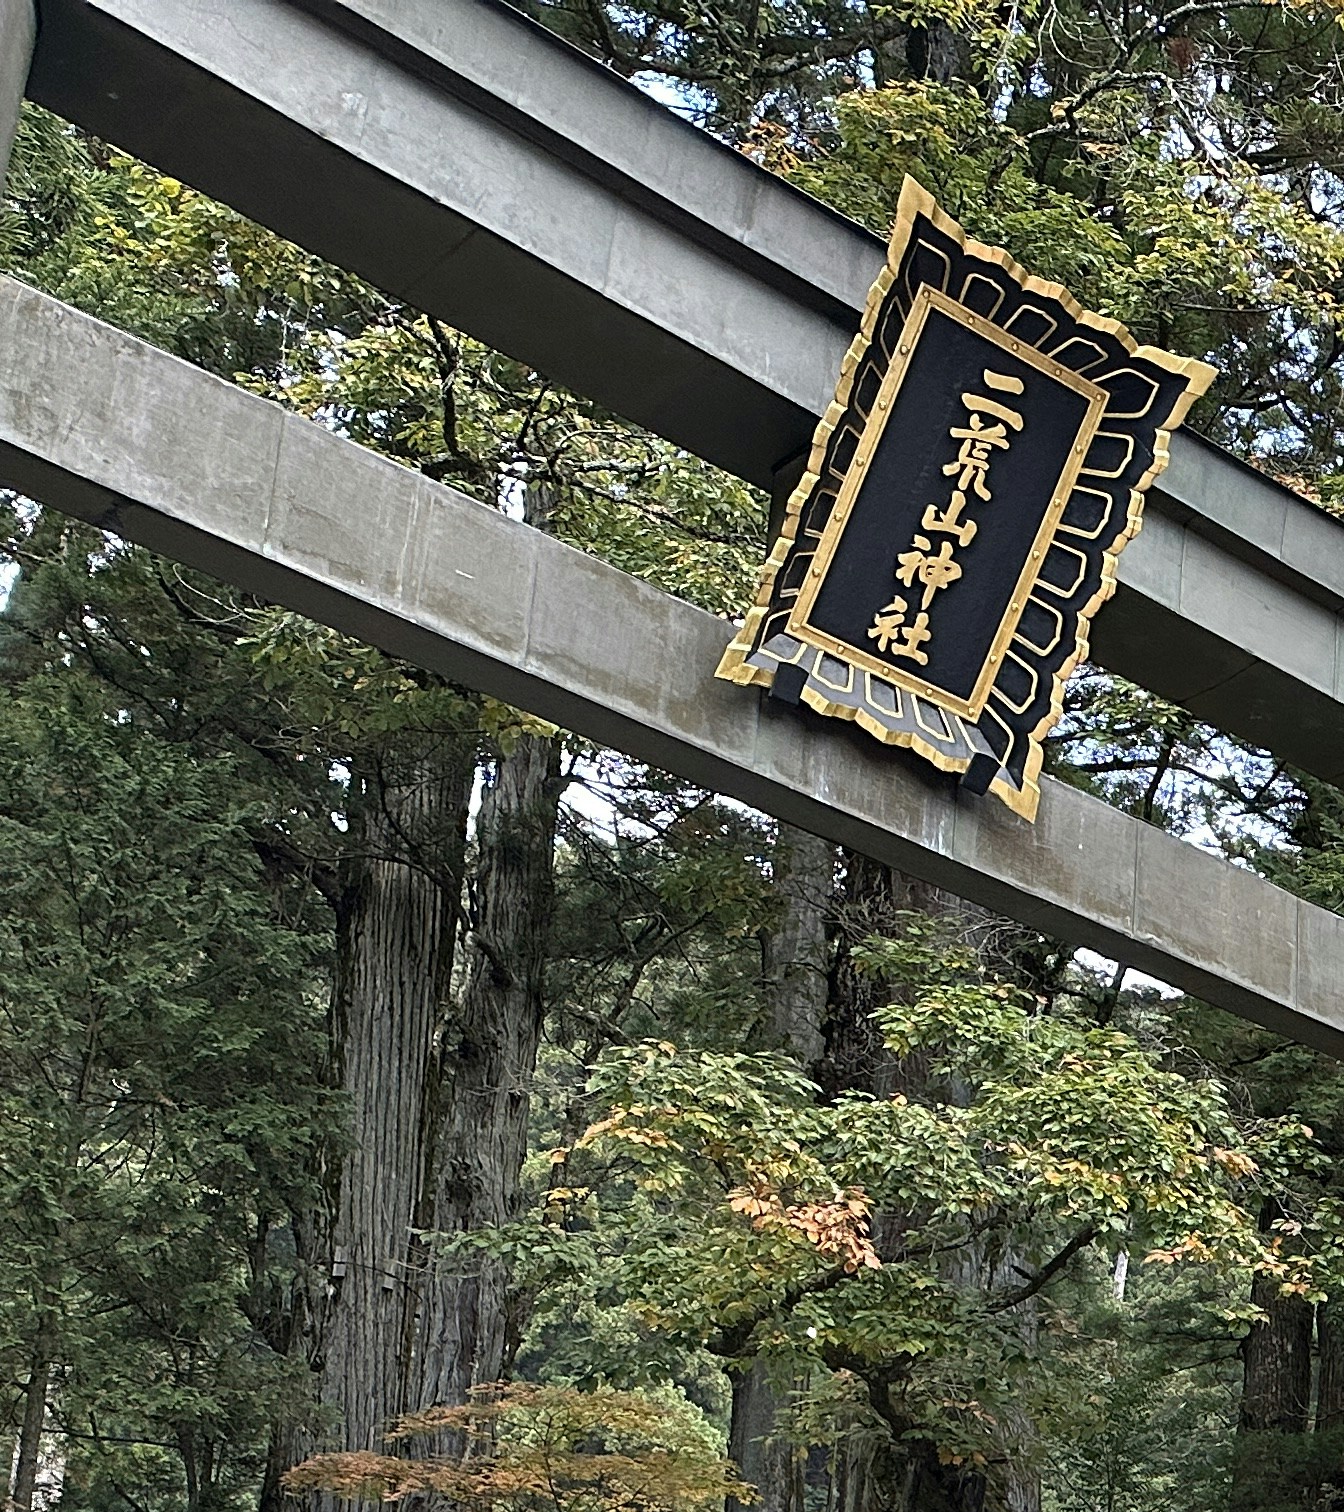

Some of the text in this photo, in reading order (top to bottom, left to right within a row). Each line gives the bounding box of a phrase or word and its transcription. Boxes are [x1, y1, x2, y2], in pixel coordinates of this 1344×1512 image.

[868, 368, 1025, 666] 二荒山神社
